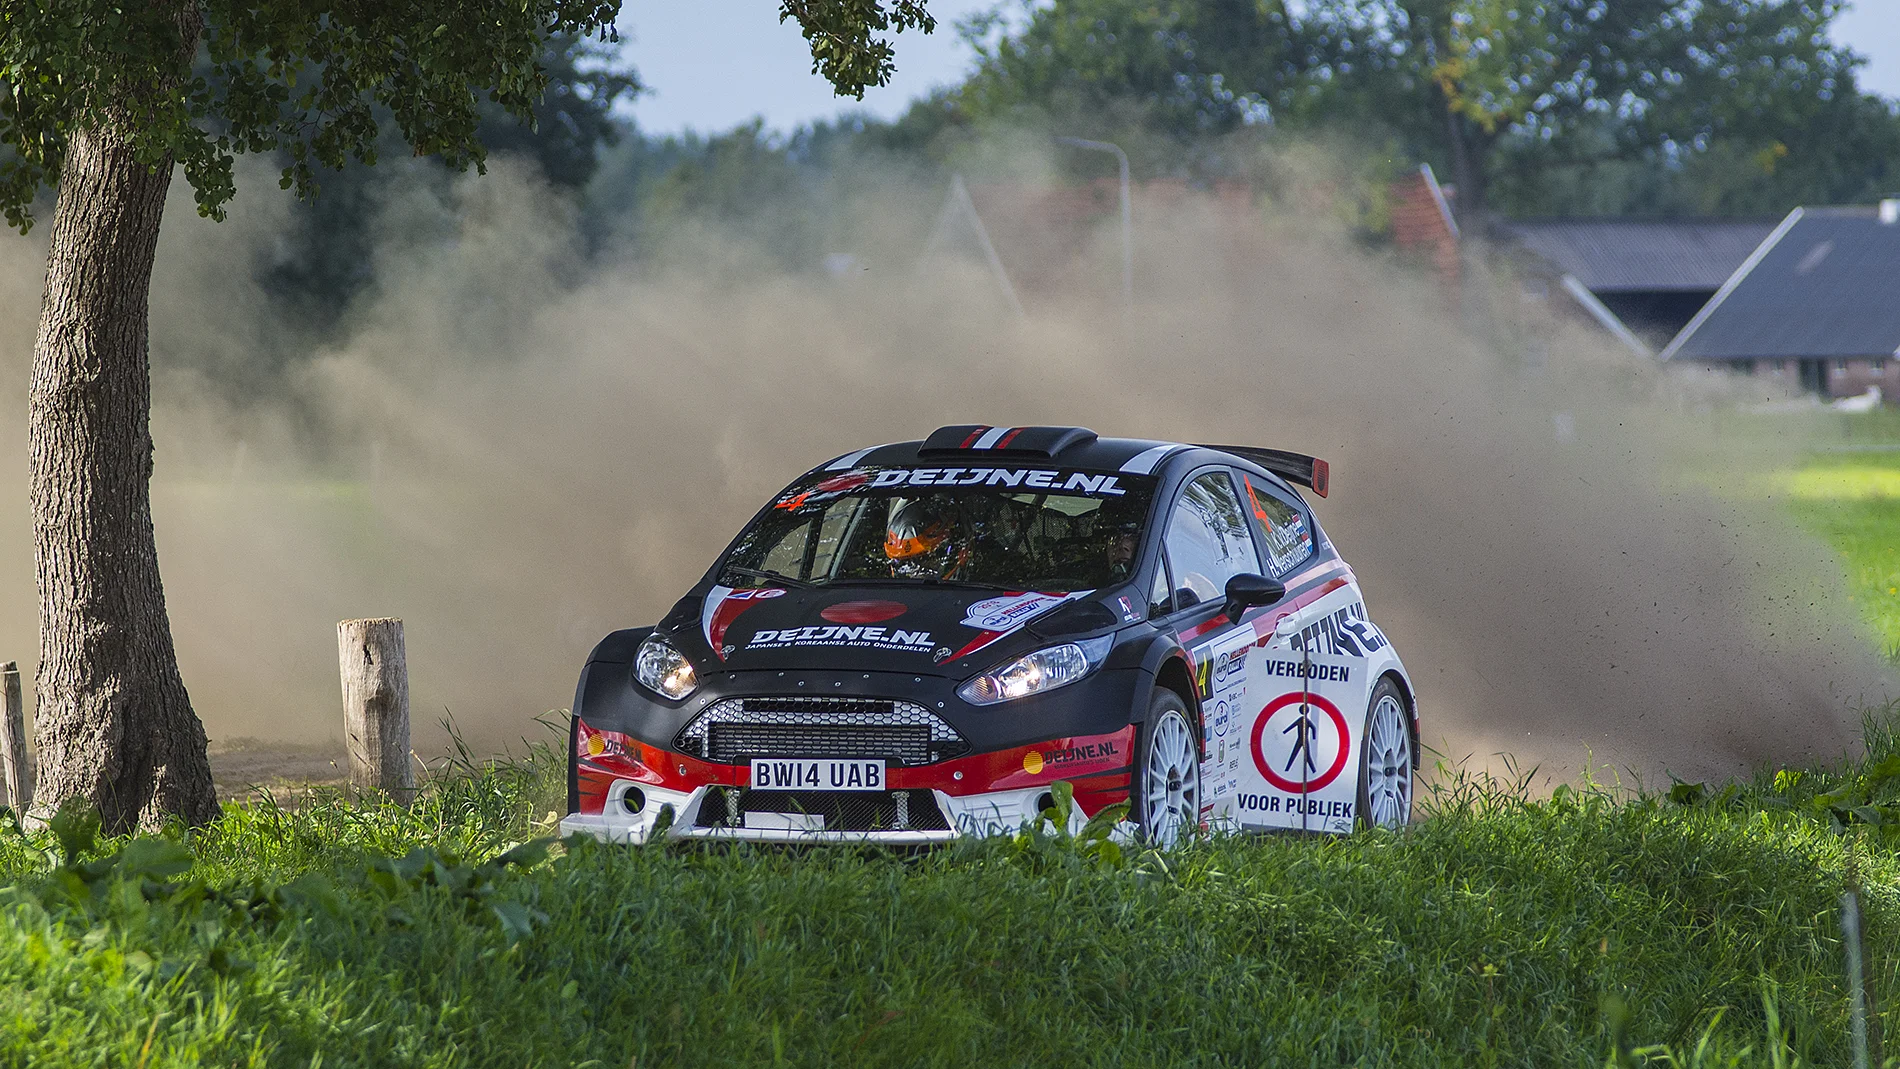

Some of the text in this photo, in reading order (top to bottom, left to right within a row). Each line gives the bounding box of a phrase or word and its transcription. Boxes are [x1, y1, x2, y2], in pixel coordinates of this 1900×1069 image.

[872, 468, 1127, 496] DEIJNE.NL
[774, 491, 812, 512] 4
[1243, 474, 1273, 533] 4
[744, 642, 782, 650] JAPANSE
[873, 642, 932, 653] ONDERDELEN
[750, 626, 936, 647] DEIJNE.NL
[1198, 652, 1208, 697] 4
[1266, 659, 1350, 682] VERBODEN
[1044, 741, 1119, 765] DEIJNE.NL
[830, 762, 880, 787] UAB
[1237, 793, 1353, 818] VOOR PUBLIEK
